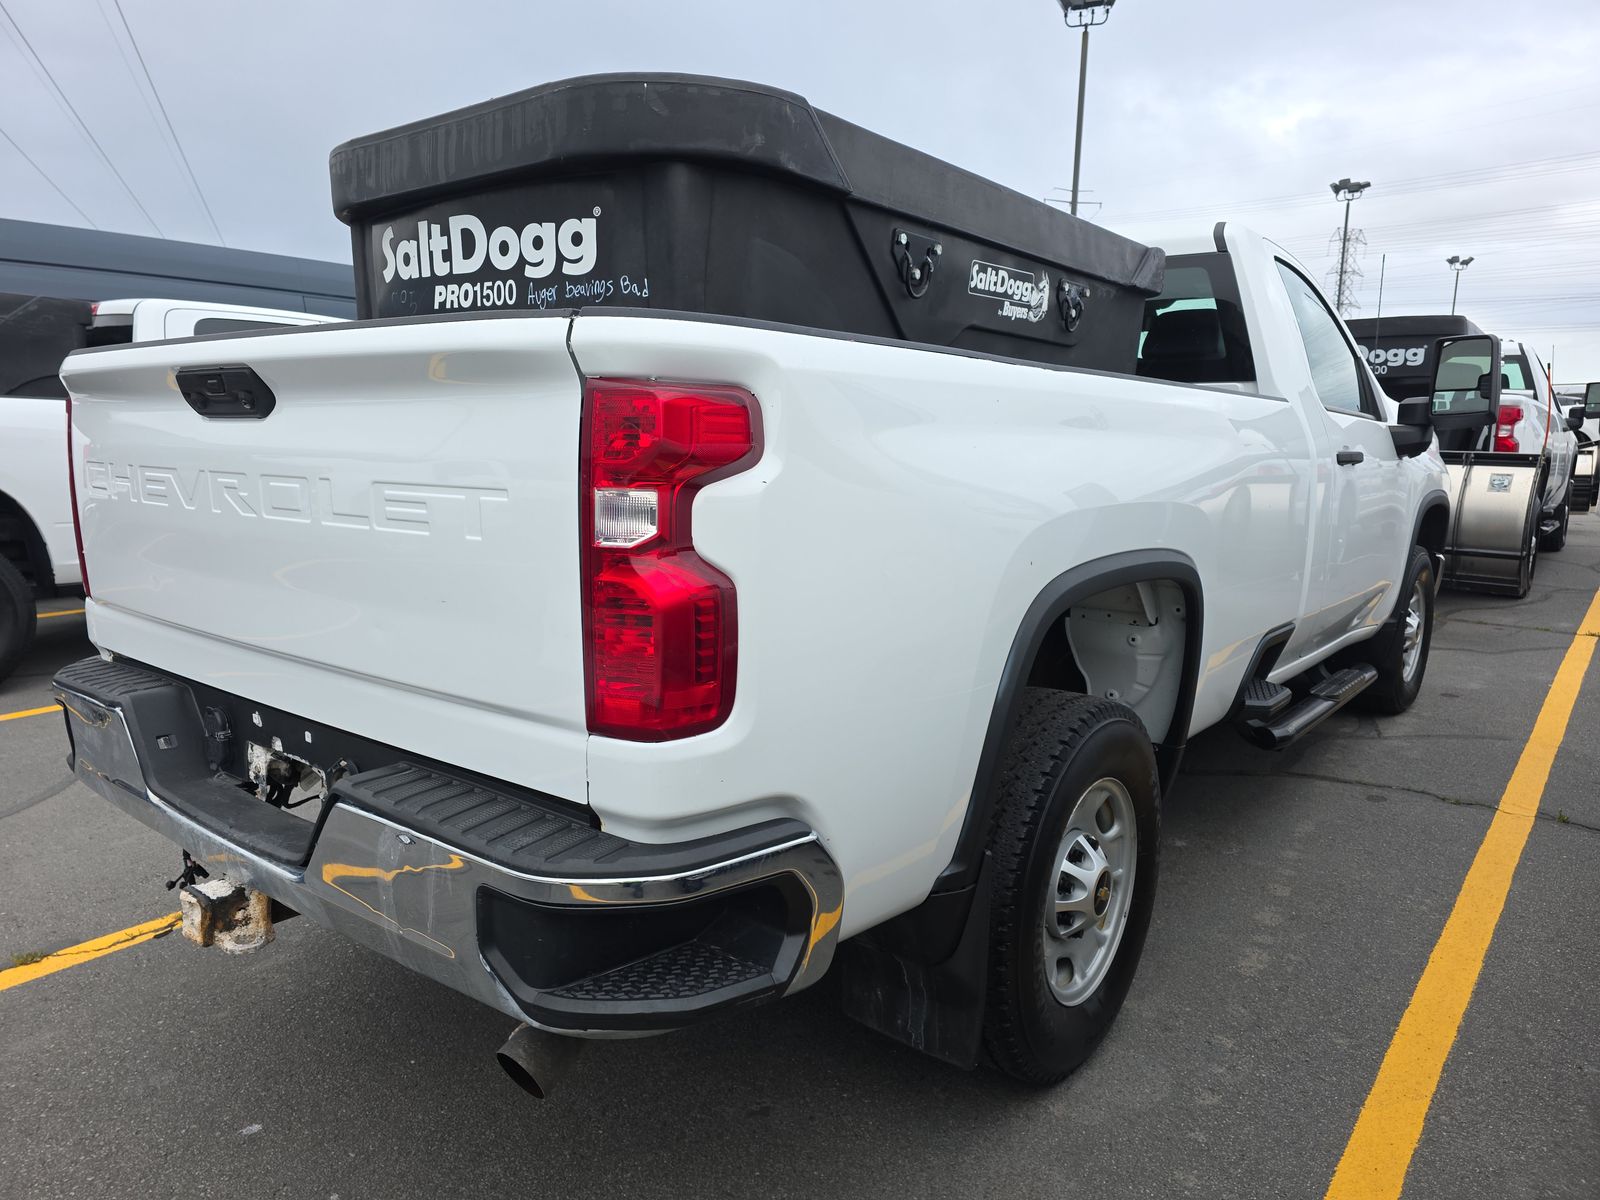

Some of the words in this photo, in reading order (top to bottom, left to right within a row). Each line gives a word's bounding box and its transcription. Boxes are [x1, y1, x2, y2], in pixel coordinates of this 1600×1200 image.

[382, 214, 597, 283] SaltDogg
[433, 279, 517, 310] PRO1500
[527, 282, 558, 310] Auger
[620, 275, 649, 298] Bad
[970, 264, 1032, 301] SaltDogg
[1002, 301, 1029, 320] Buyers
[1369, 365, 1388, 375] 00
[85, 460, 510, 541] CHEVROLET
